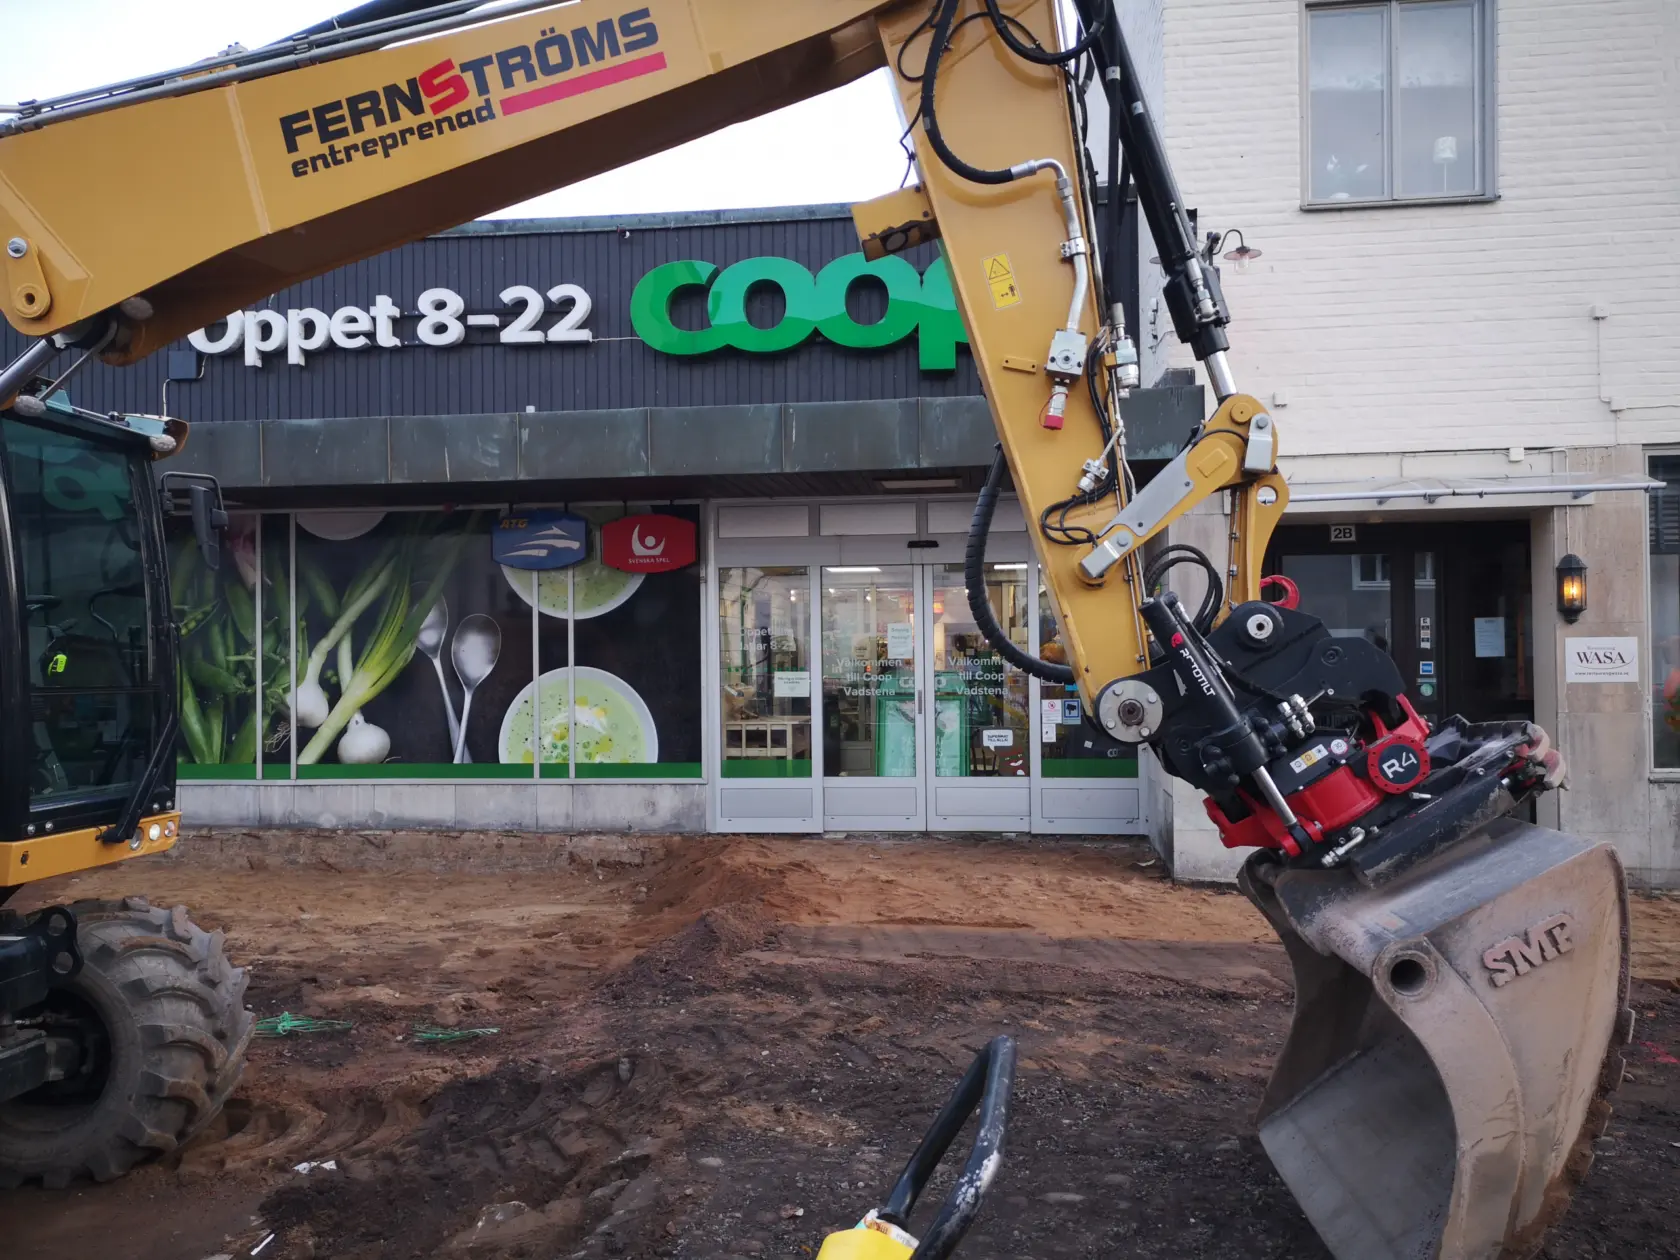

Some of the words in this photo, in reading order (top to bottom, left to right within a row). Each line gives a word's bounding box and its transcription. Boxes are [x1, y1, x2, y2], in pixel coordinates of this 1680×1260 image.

[279, 7, 659, 154] FERNSTRÖMS
[290, 100, 496, 178] entreprenad
[501, 519, 528, 529] ATG
[1333, 527, 1353, 539] 2B
[837, 658, 902, 667] Välkommen
[948, 656, 1009, 666] Välkomme
[1576, 651, 1626, 664] WASA
[847, 672, 860, 681] till
[863, 672, 892, 683] Coop
[960, 671, 973, 680] till
[975, 671, 1005, 682] Coop
[844, 686, 895, 696] Vadstena
[956, 686, 1009, 695] Vadstena
[1382, 752, 1418, 779] R4
